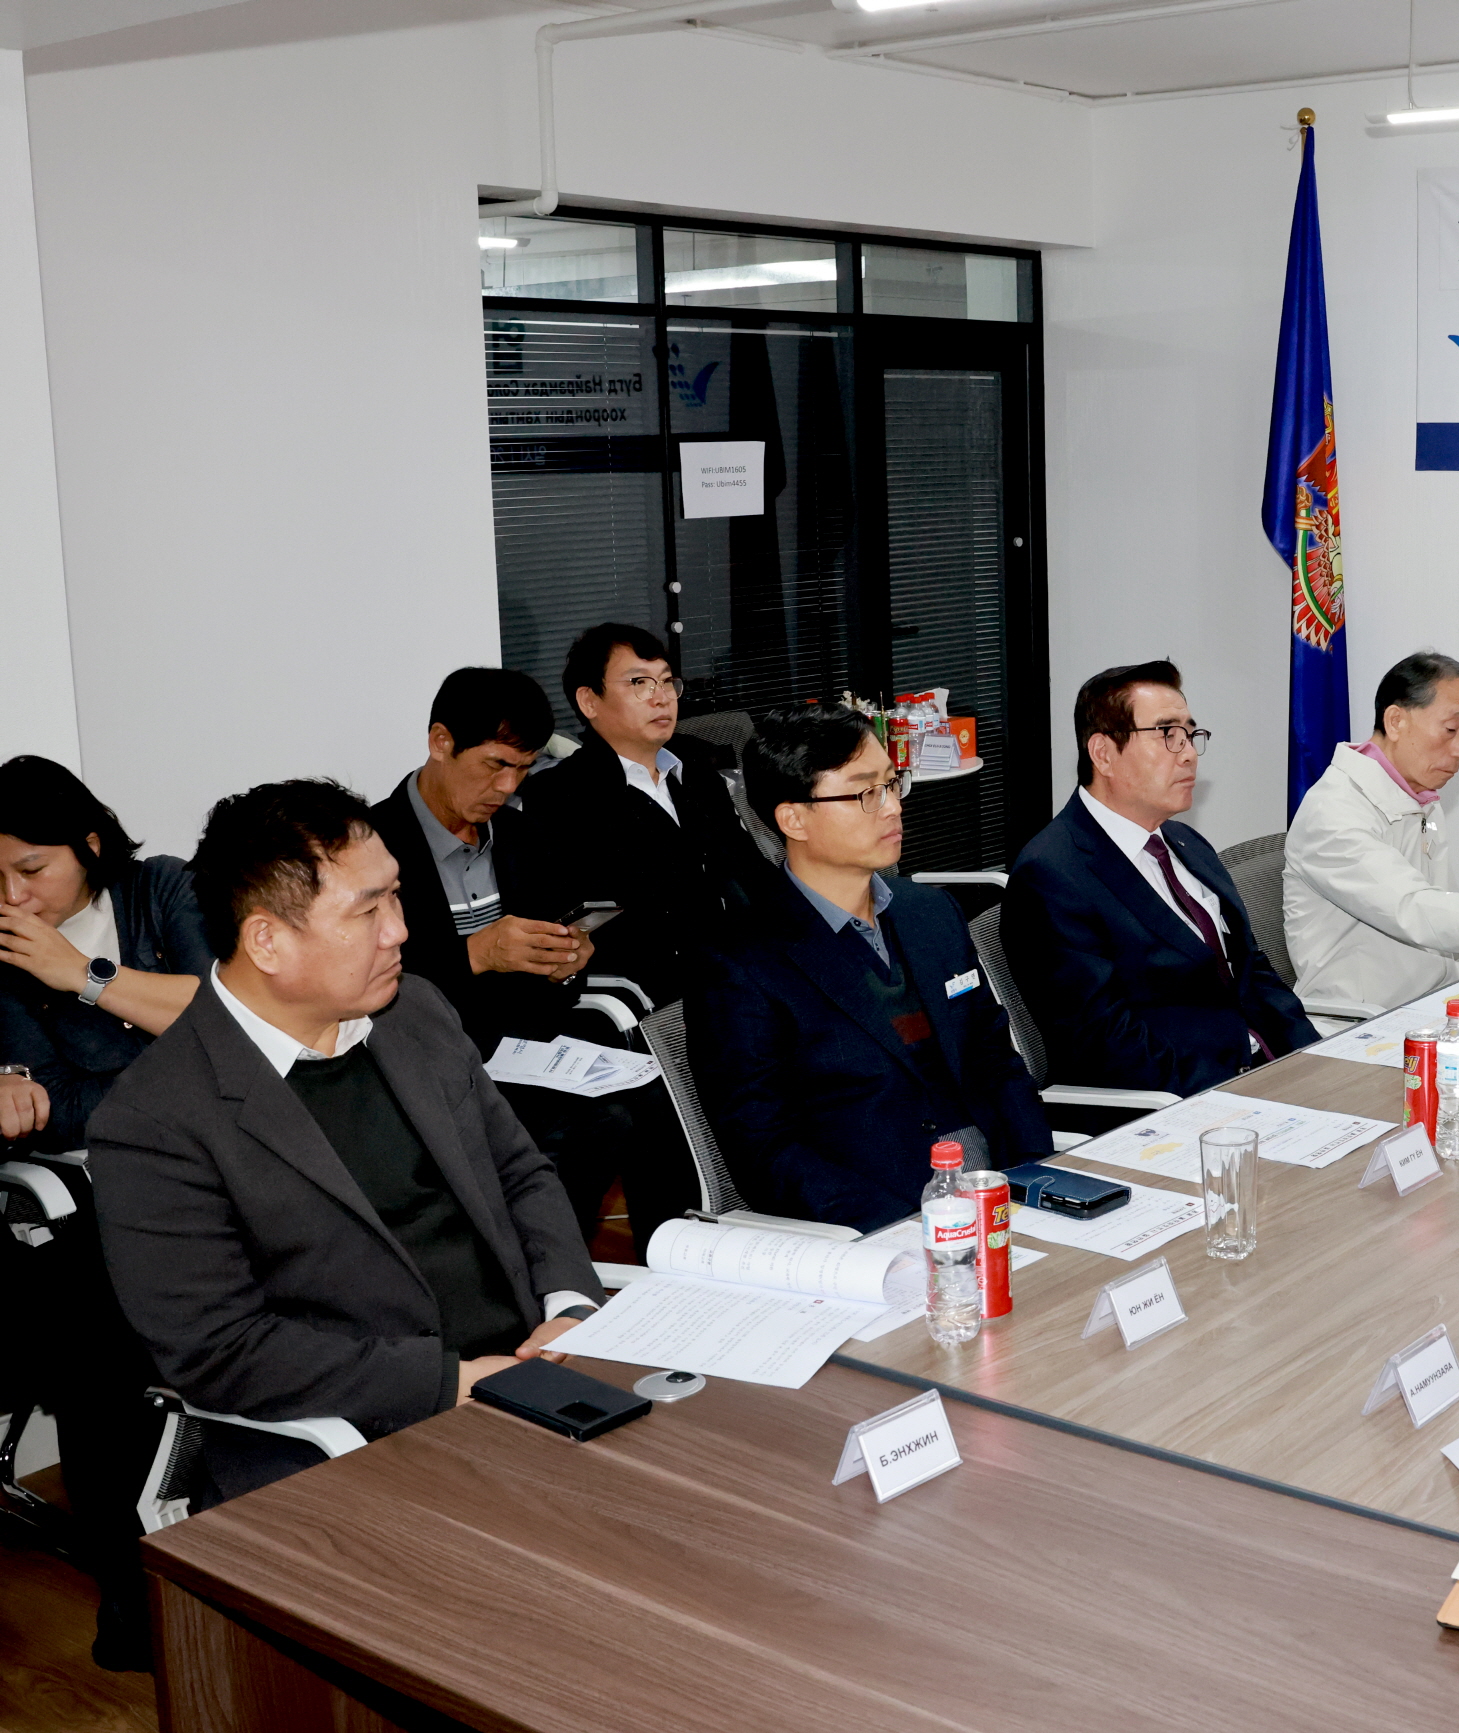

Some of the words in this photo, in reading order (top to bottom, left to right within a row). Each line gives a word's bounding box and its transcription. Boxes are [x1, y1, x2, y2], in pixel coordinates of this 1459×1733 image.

[1129, 1303, 1142, 1316] ЮН
[1142, 1297, 1154, 1310] ЖИ
[1154, 1292, 1165, 1304] ЁН
[879, 1430, 939, 1468] Б.ЭНХЖИН
